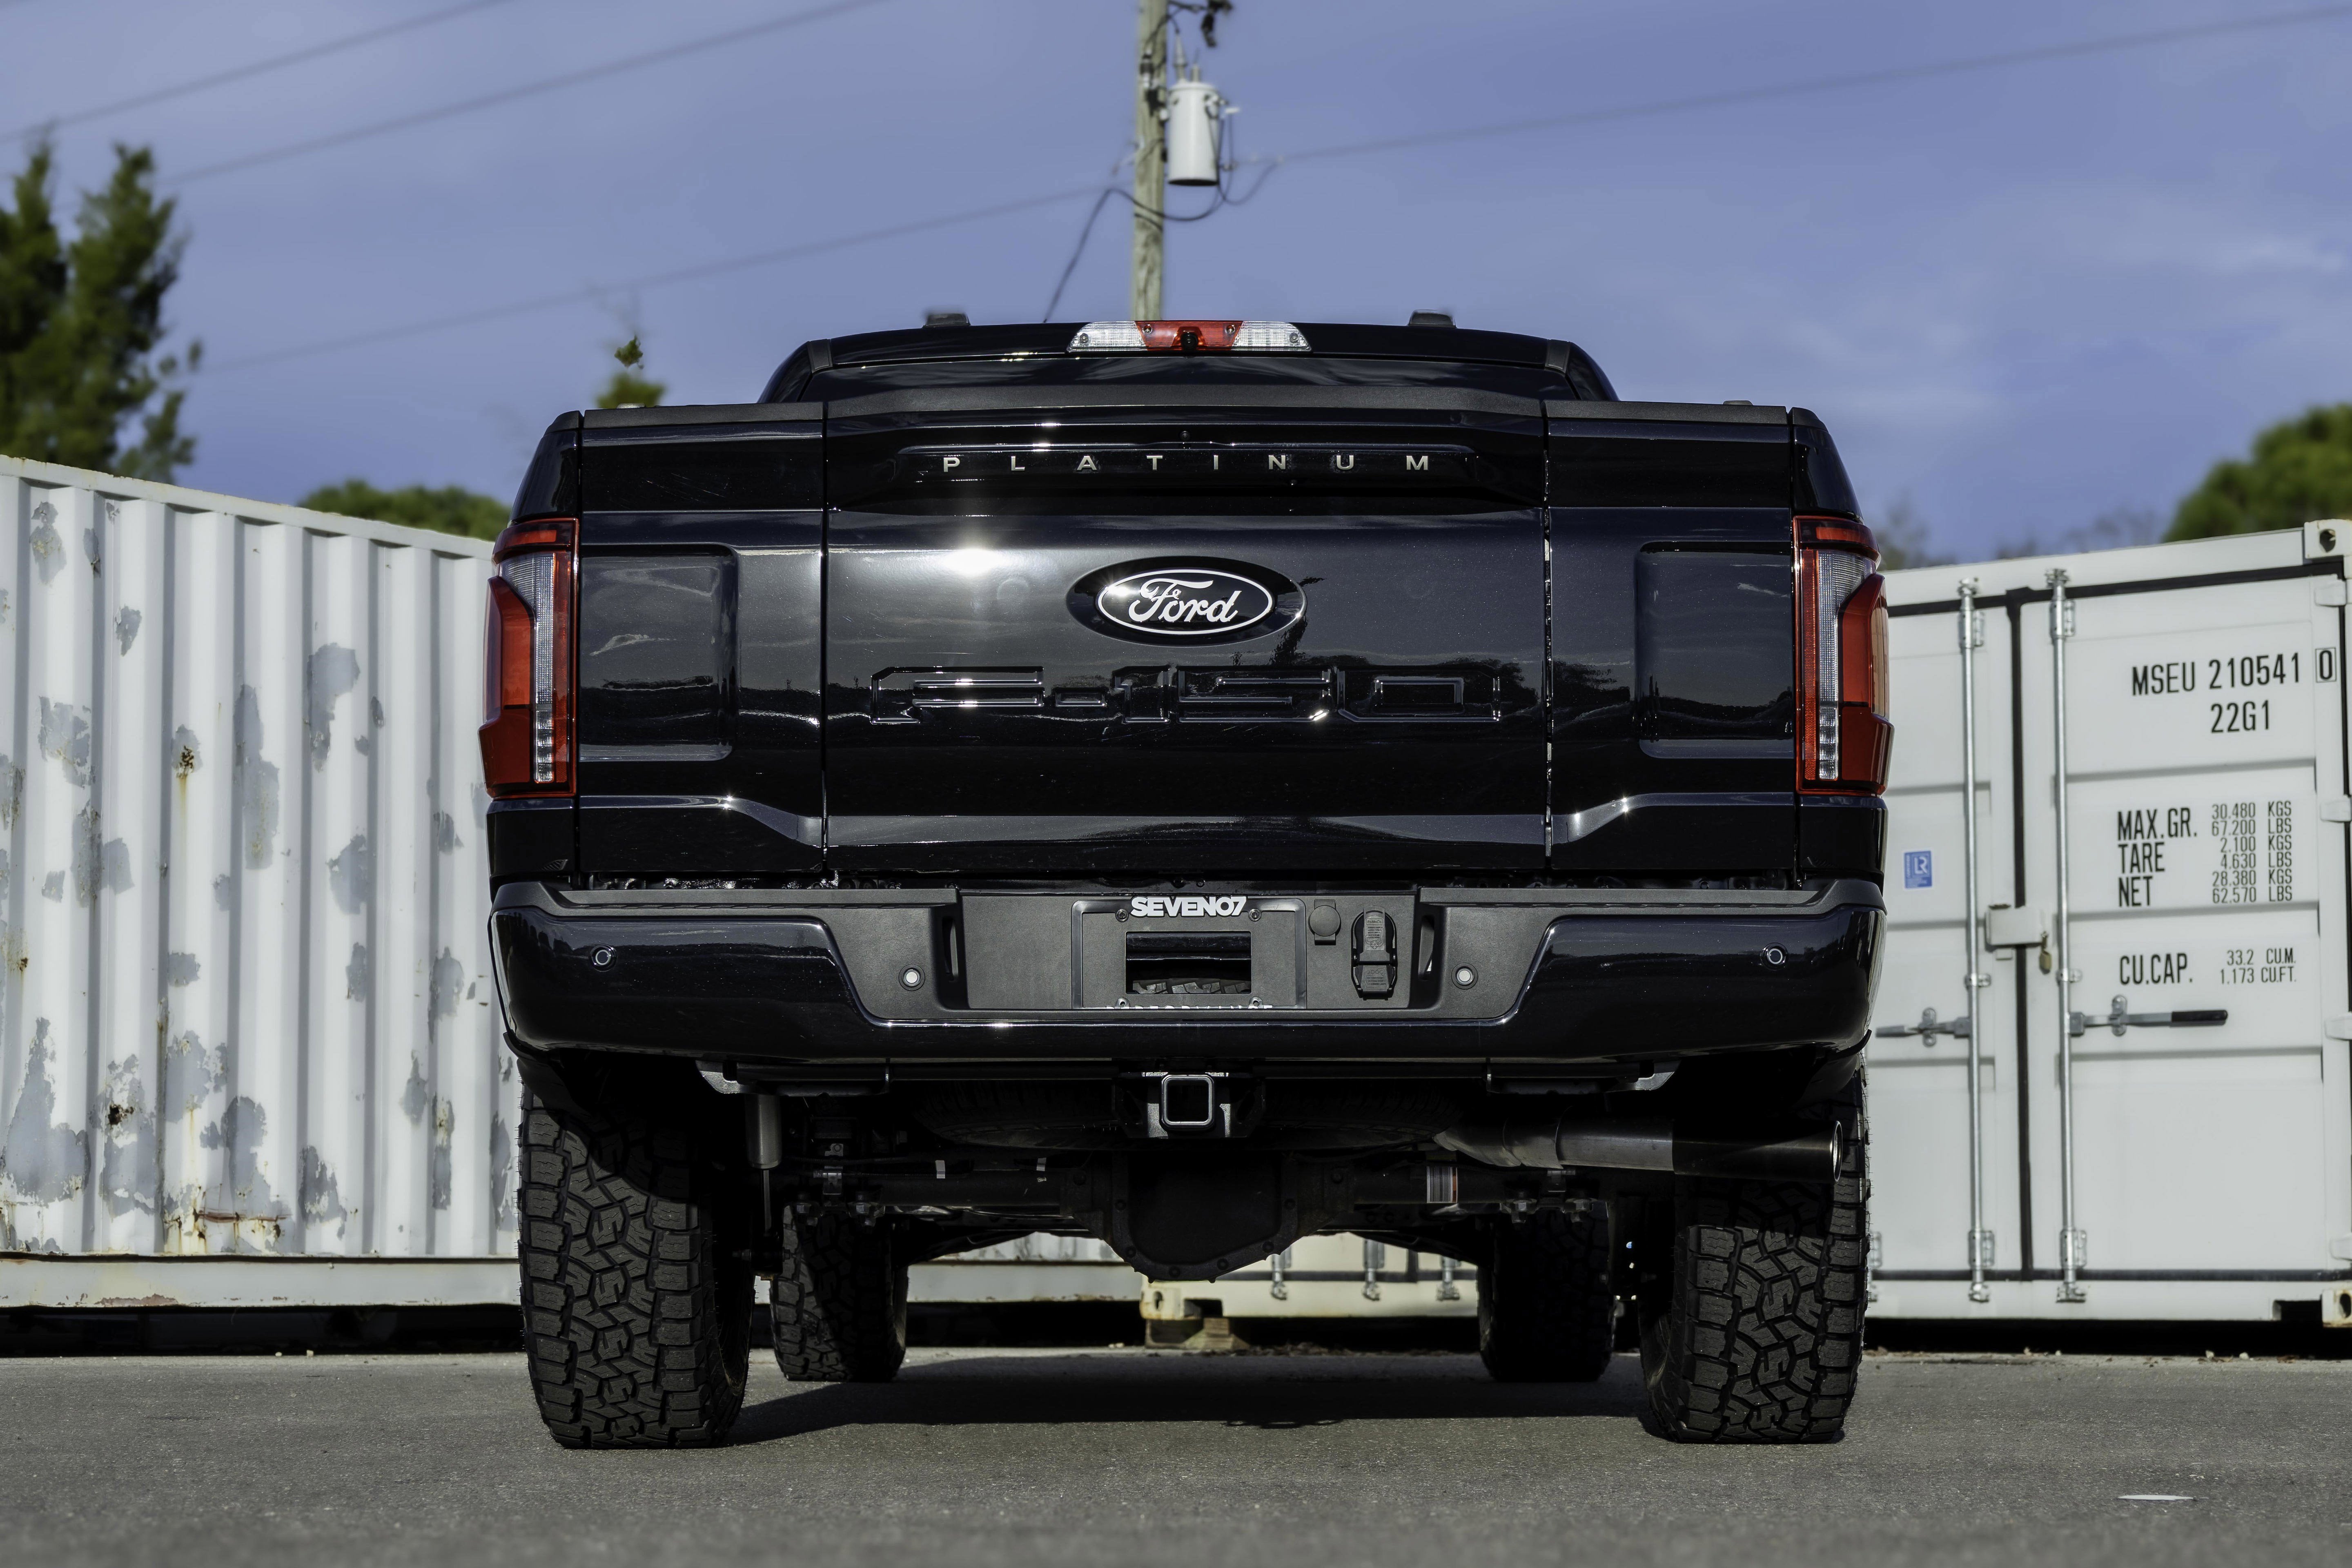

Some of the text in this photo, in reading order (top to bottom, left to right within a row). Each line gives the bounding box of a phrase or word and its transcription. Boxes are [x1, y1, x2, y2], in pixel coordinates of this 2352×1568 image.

[943, 455, 1428, 472] PLATINUM
[1128, 578, 1243, 622] Ford
[2132, 650, 2333, 696] MSEU 210541 0
[870, 666, 1500, 724] F-150
[2211, 699, 2270, 733] 22G1
[2212, 800, 2292, 820] 30.480 KGS
[2212, 817, 2292, 836] 67.200 LBS
[2220, 835, 2292, 853] 2.100 KGS
[2118, 842, 2165, 874] TARE
[2221, 851, 2292, 869] 4.630 LBS
[2212, 869, 2292, 887] 28.380 KGS
[2118, 875, 2153, 907] NET
[2212, 885, 2292, 904] 62.570 LBS
[2120, 953, 2193, 986] CU.CAP.
[2227, 949, 2254, 966] 33.2
[2221, 968, 2254, 984] 1.173
